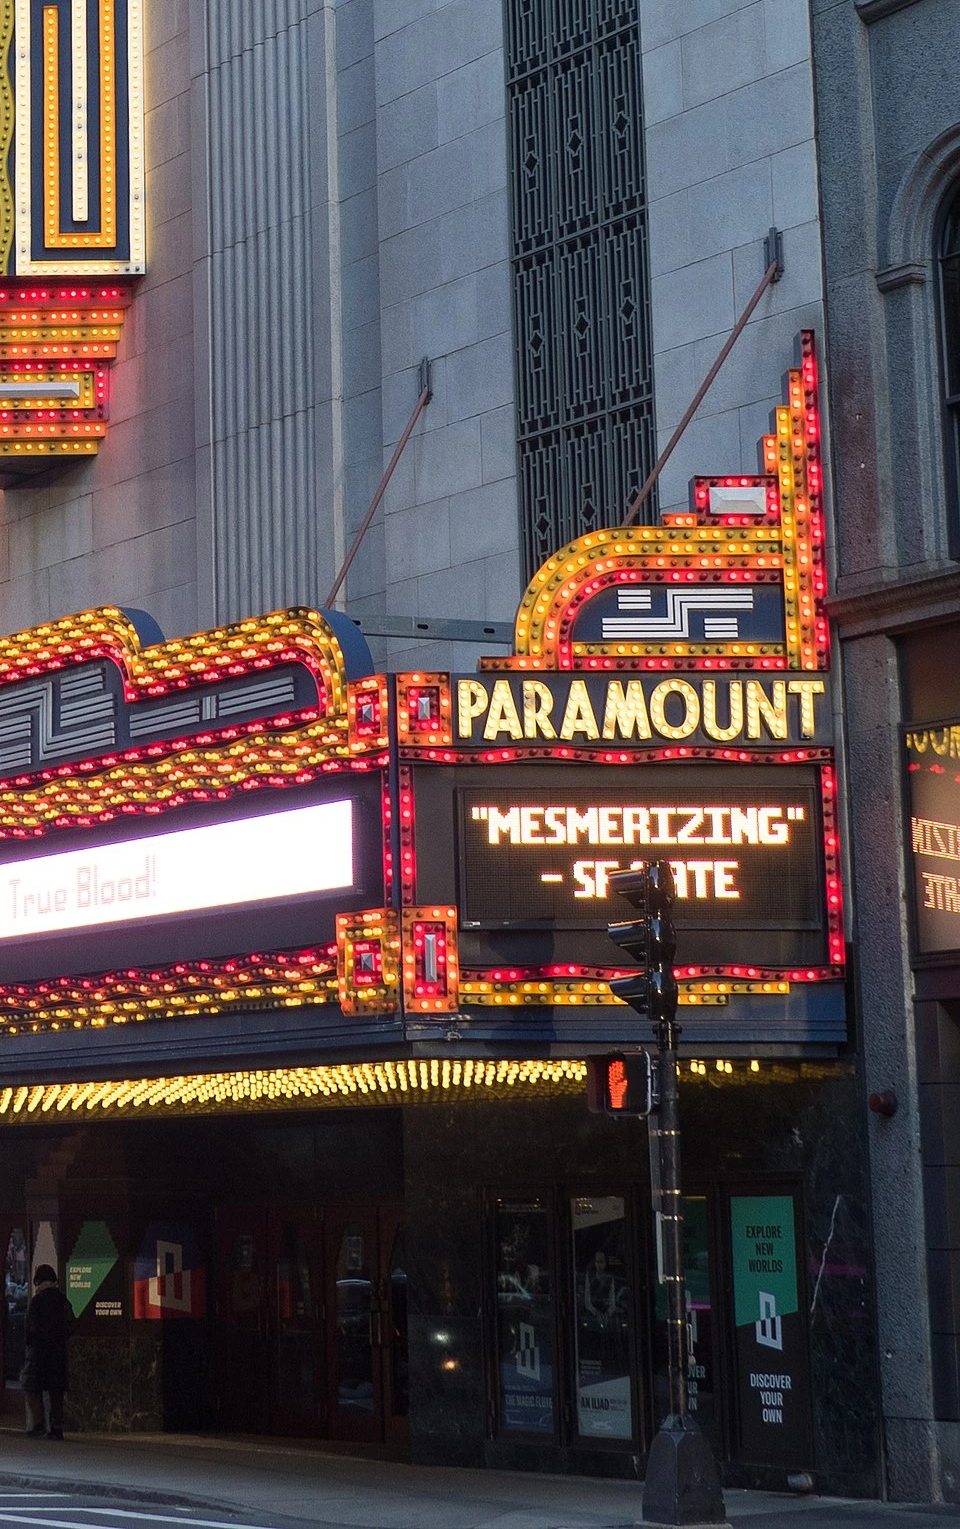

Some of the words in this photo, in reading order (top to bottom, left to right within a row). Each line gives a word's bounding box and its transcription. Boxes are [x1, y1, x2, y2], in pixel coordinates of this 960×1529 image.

[458, 679, 825, 741] PARAMOUNT
[471, 807, 805, 845] "MESMERIZING"
[9, 878, 67, 919] True
[77, 854, 157, 909] Blood!
[572, 861, 740, 898] SFATE
[746, 1225, 783, 1239] EXPLORE
[755, 1243, 774, 1255] NEW
[749, 1259, 784, 1273] WORLDS
[750, 1373, 792, 1389] DISCOVER
[581, 1396, 590, 1409] AN
[591, 1397, 610, 1411] ILIAD
[760, 1391, 783, 1406] YOUR
[762, 1408, 783, 1424] OWN
